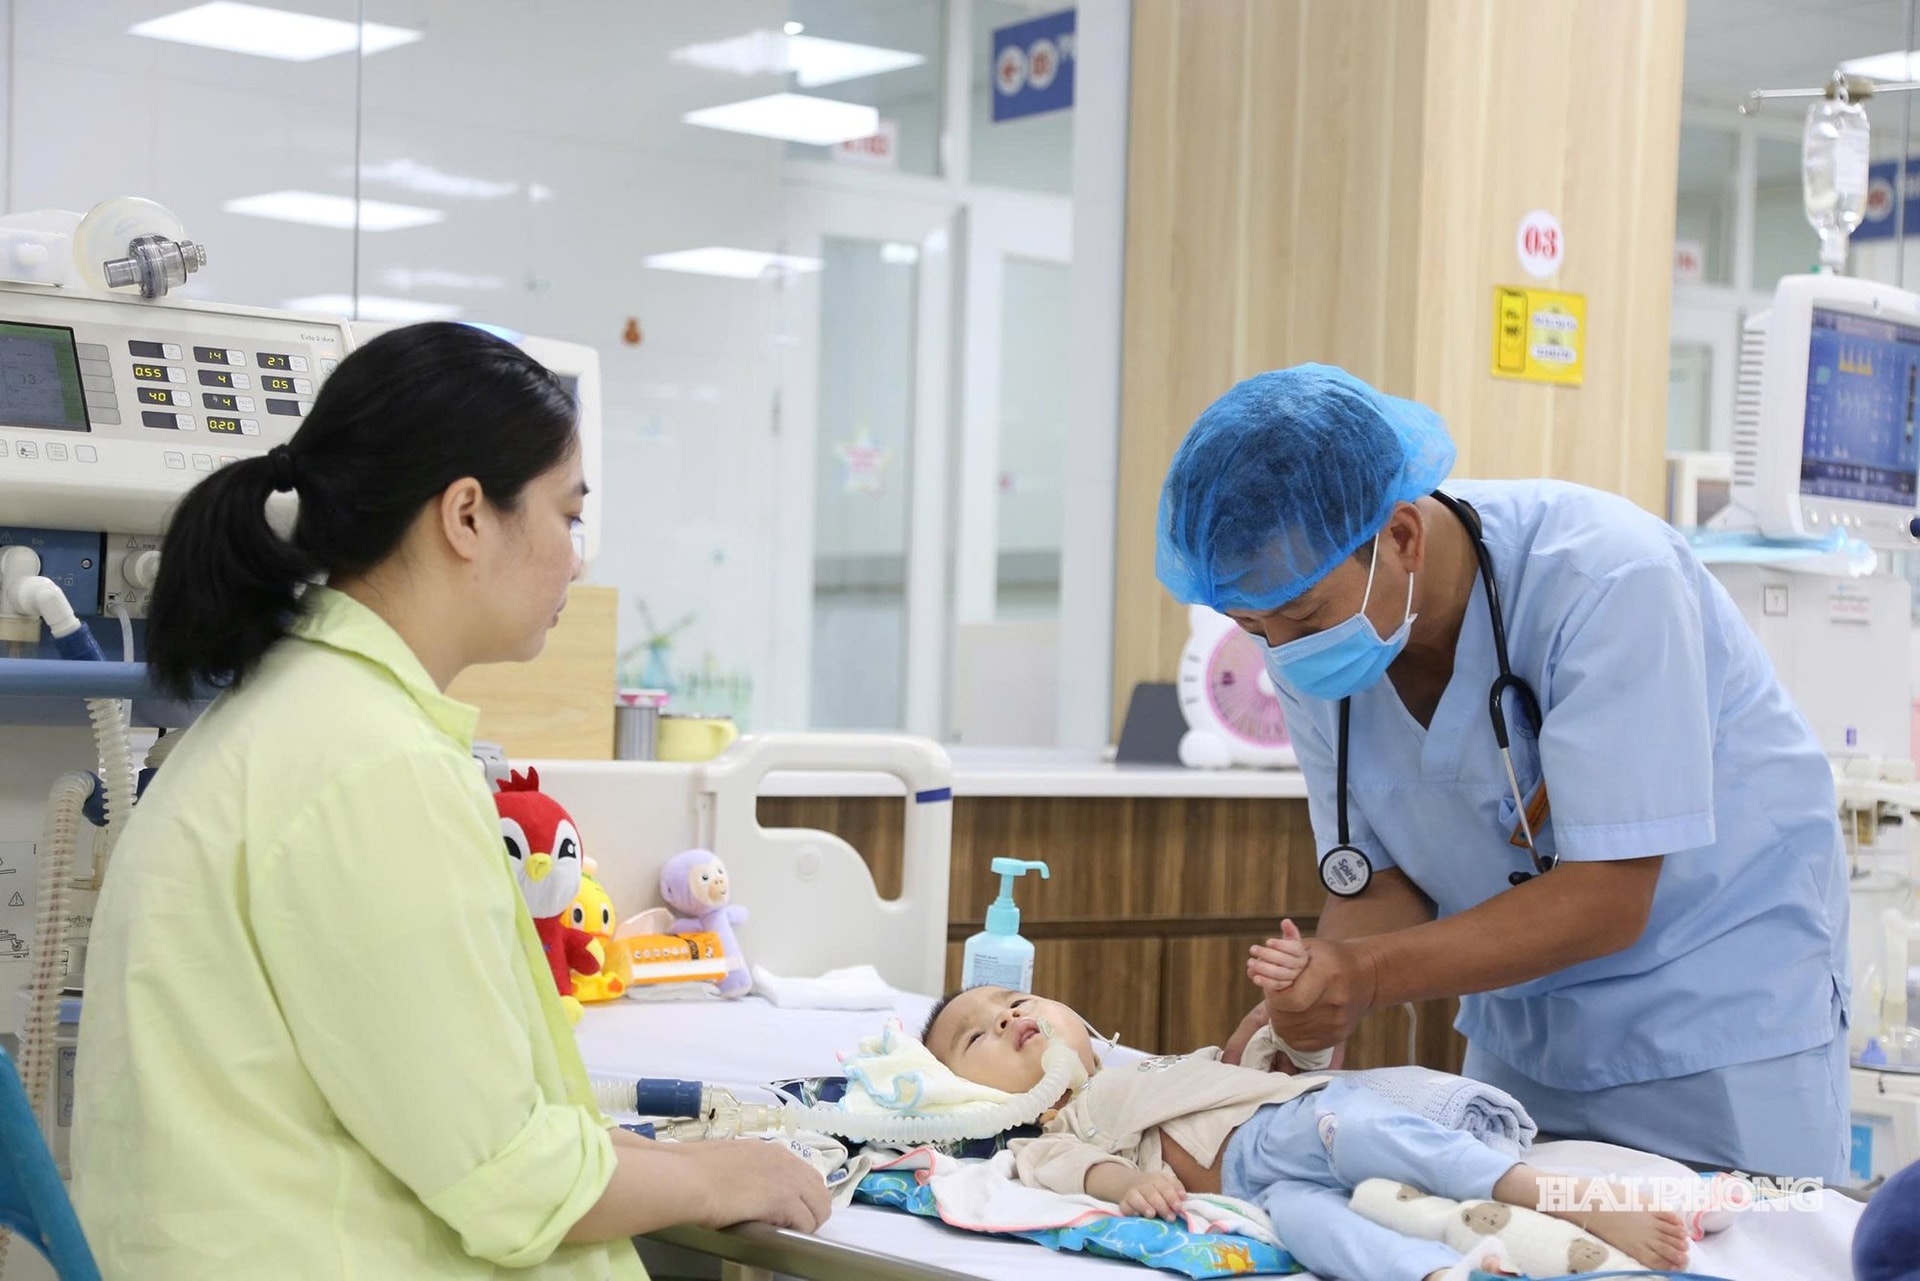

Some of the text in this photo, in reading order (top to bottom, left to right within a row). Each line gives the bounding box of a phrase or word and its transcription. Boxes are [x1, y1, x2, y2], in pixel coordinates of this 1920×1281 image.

[1524, 225, 1558, 259] 03
[208, 351, 222, 360] 14
[267, 357, 285, 367] 27
[148, 391, 167, 402] 40
[1338, 858, 1357, 882] Spirit
